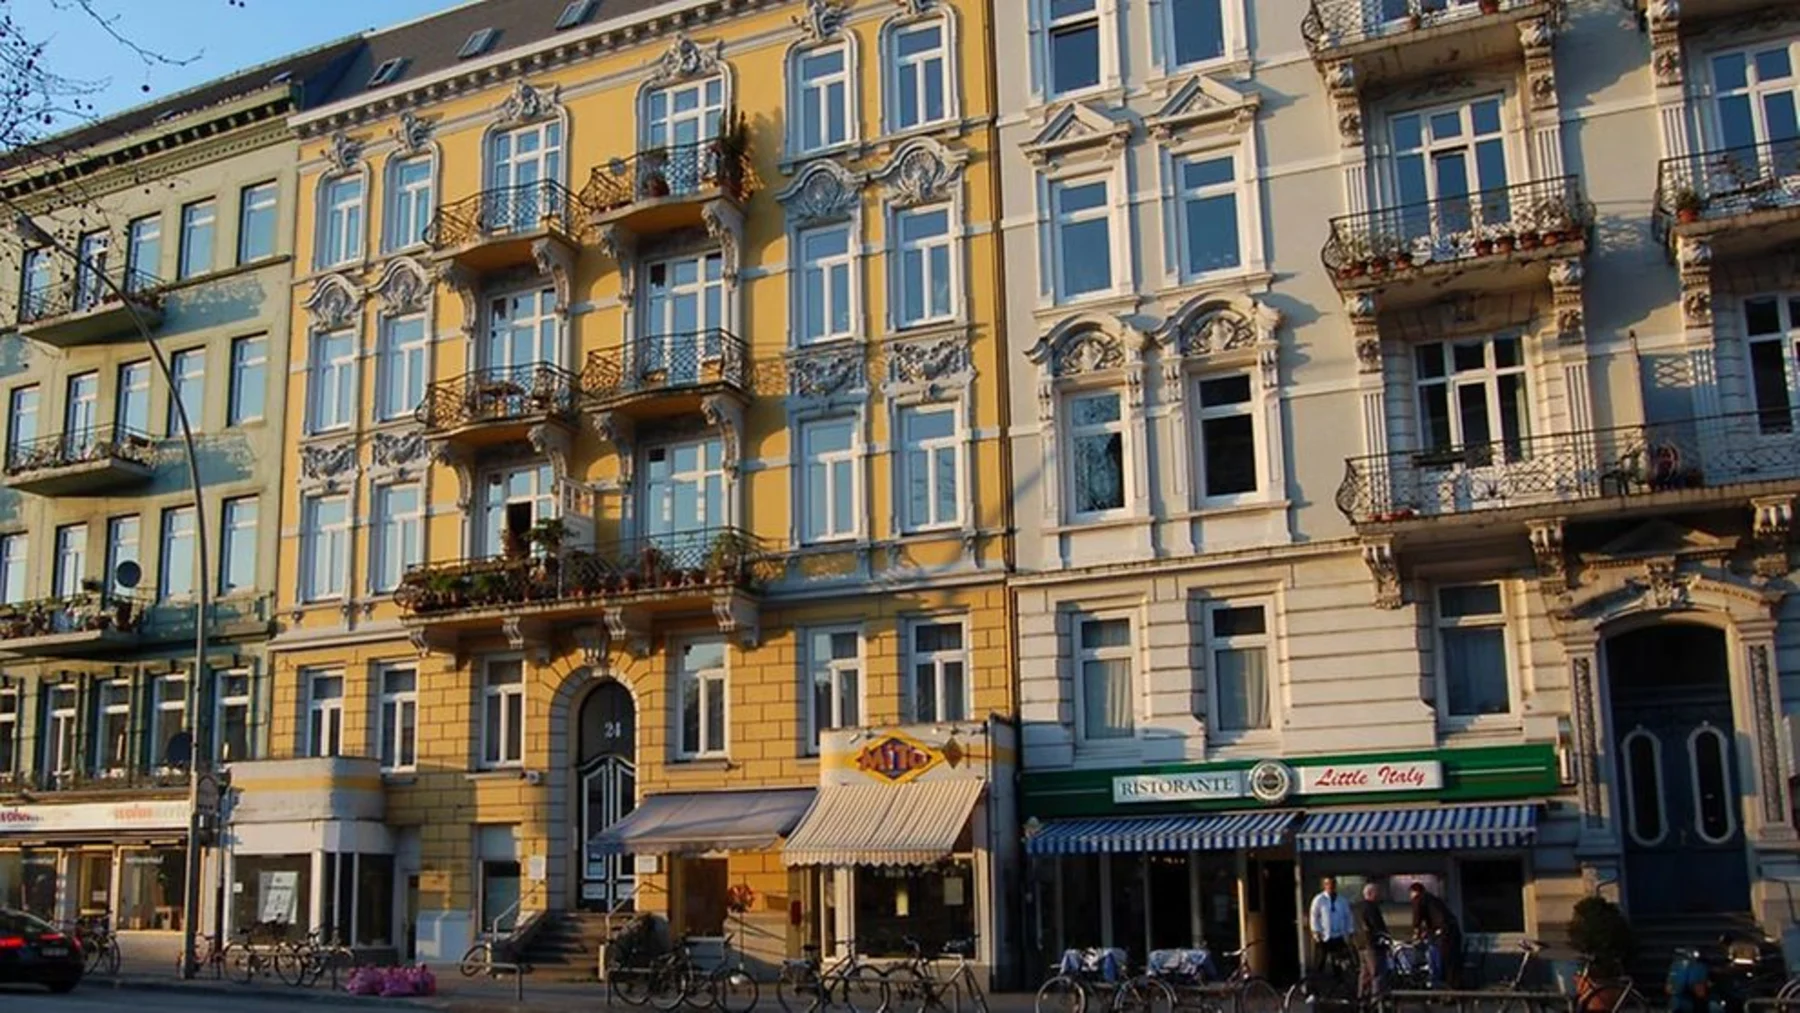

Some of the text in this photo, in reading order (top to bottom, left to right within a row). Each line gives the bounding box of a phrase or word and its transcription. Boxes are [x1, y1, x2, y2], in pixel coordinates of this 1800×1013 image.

[1315, 765, 1425, 786] Little Italy
[1121, 777, 1234, 796] RISTORANTE
